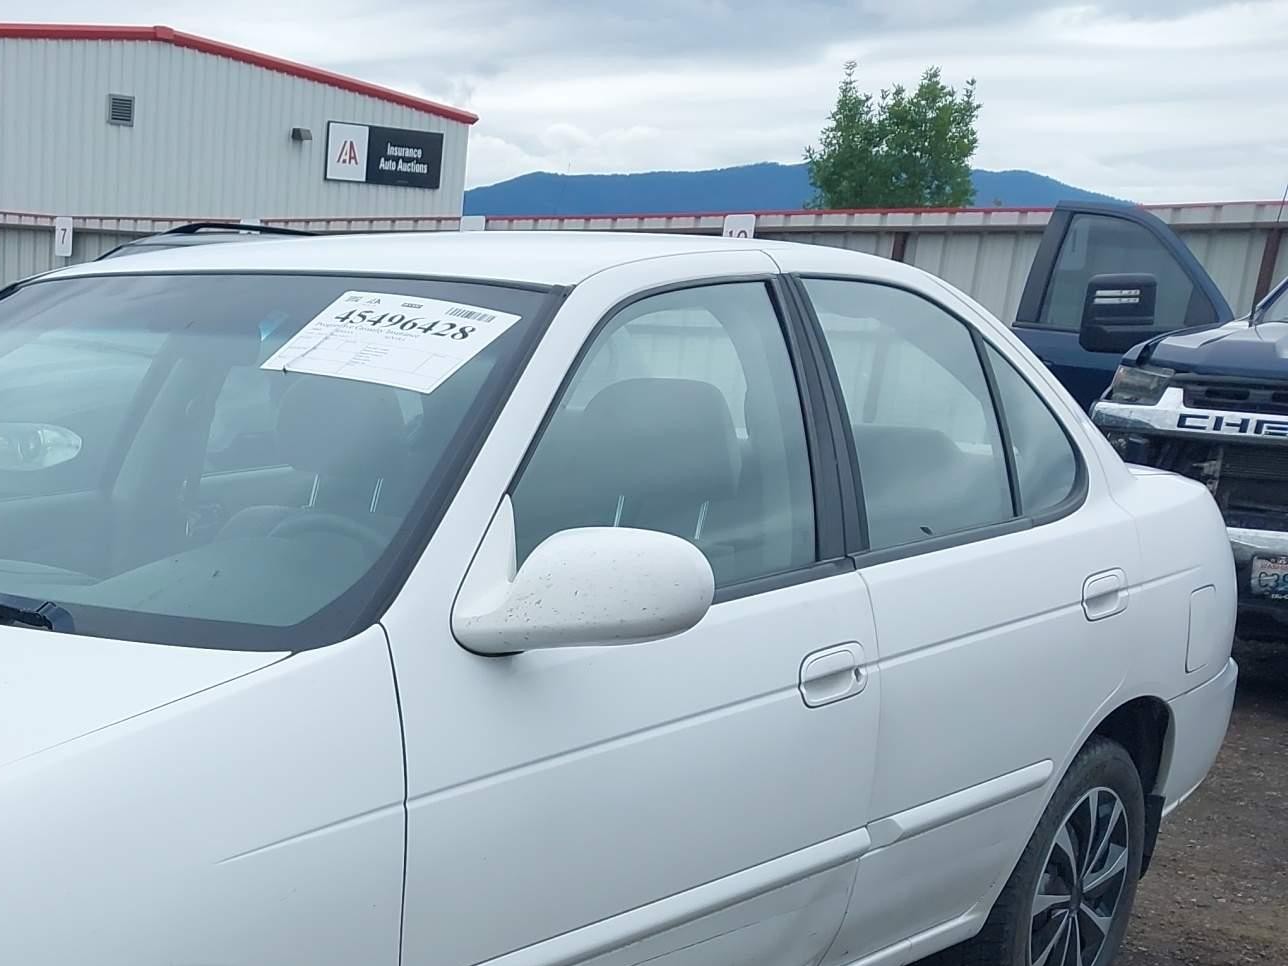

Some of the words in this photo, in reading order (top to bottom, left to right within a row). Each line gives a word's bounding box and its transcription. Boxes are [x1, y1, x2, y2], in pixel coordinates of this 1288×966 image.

[387, 142, 422, 158] Insurance
[379, 158, 396, 171] Auto
[397, 159, 428, 174] Auctions
[60, 228, 68, 244] 7
[334, 309, 476, 340] 45496428
